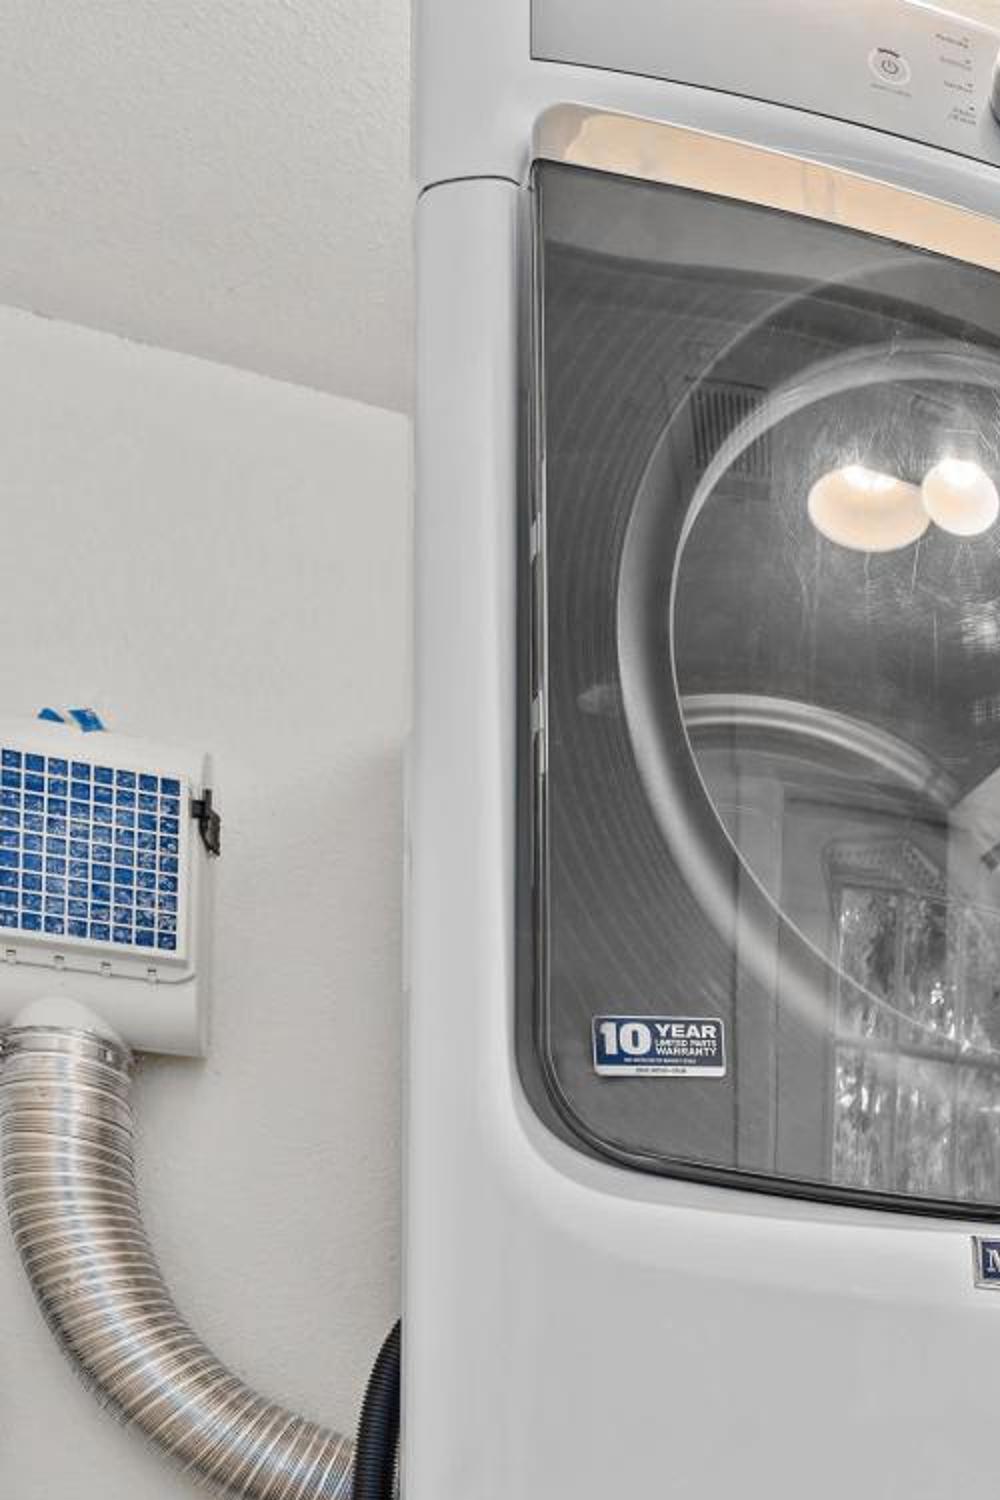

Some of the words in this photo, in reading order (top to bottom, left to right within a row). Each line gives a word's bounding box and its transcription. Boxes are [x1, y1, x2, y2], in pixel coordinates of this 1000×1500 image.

[600, 1021, 652, 1056] 10
[654, 1023, 717, 1039] YEAR
[655, 1039, 688, 1047] LIMITED
[690, 1039, 718, 1047] PARTS
[655, 1047, 718, 1057] WARRANTY
